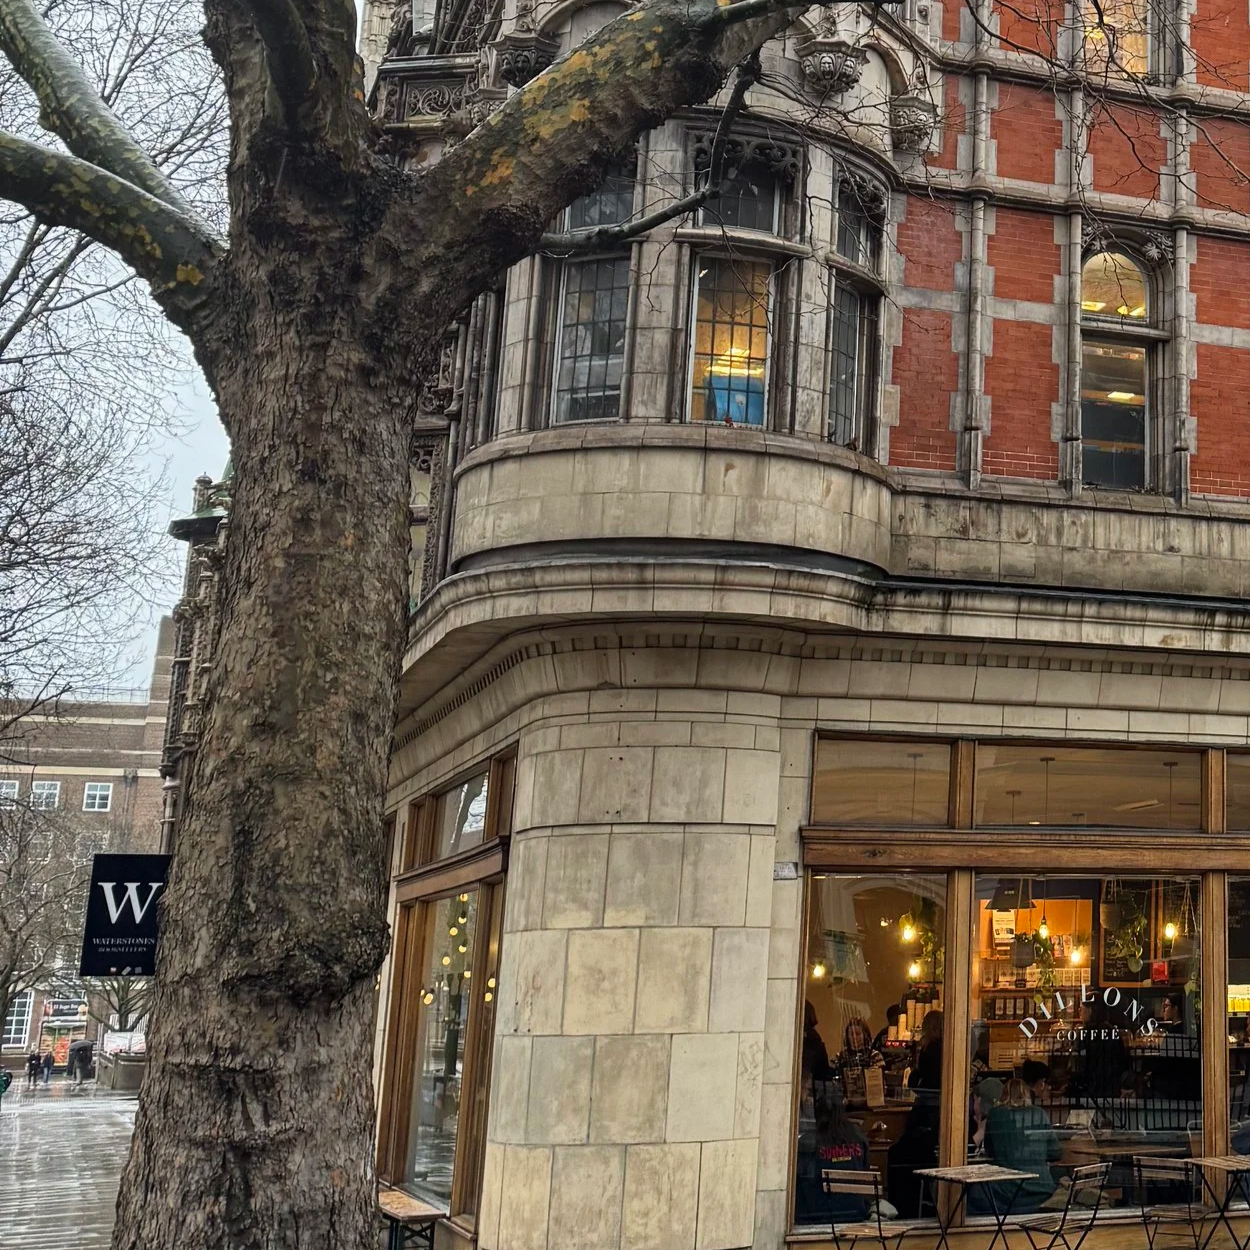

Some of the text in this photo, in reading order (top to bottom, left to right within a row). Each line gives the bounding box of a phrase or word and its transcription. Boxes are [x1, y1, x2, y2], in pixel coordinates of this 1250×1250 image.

[97, 882, 164, 925] W
[92, 937, 155, 945] WATERSTONES
[1018, 984, 1159, 1039] DILLONS
[1056, 1030, 1120, 1041] COFFEE
